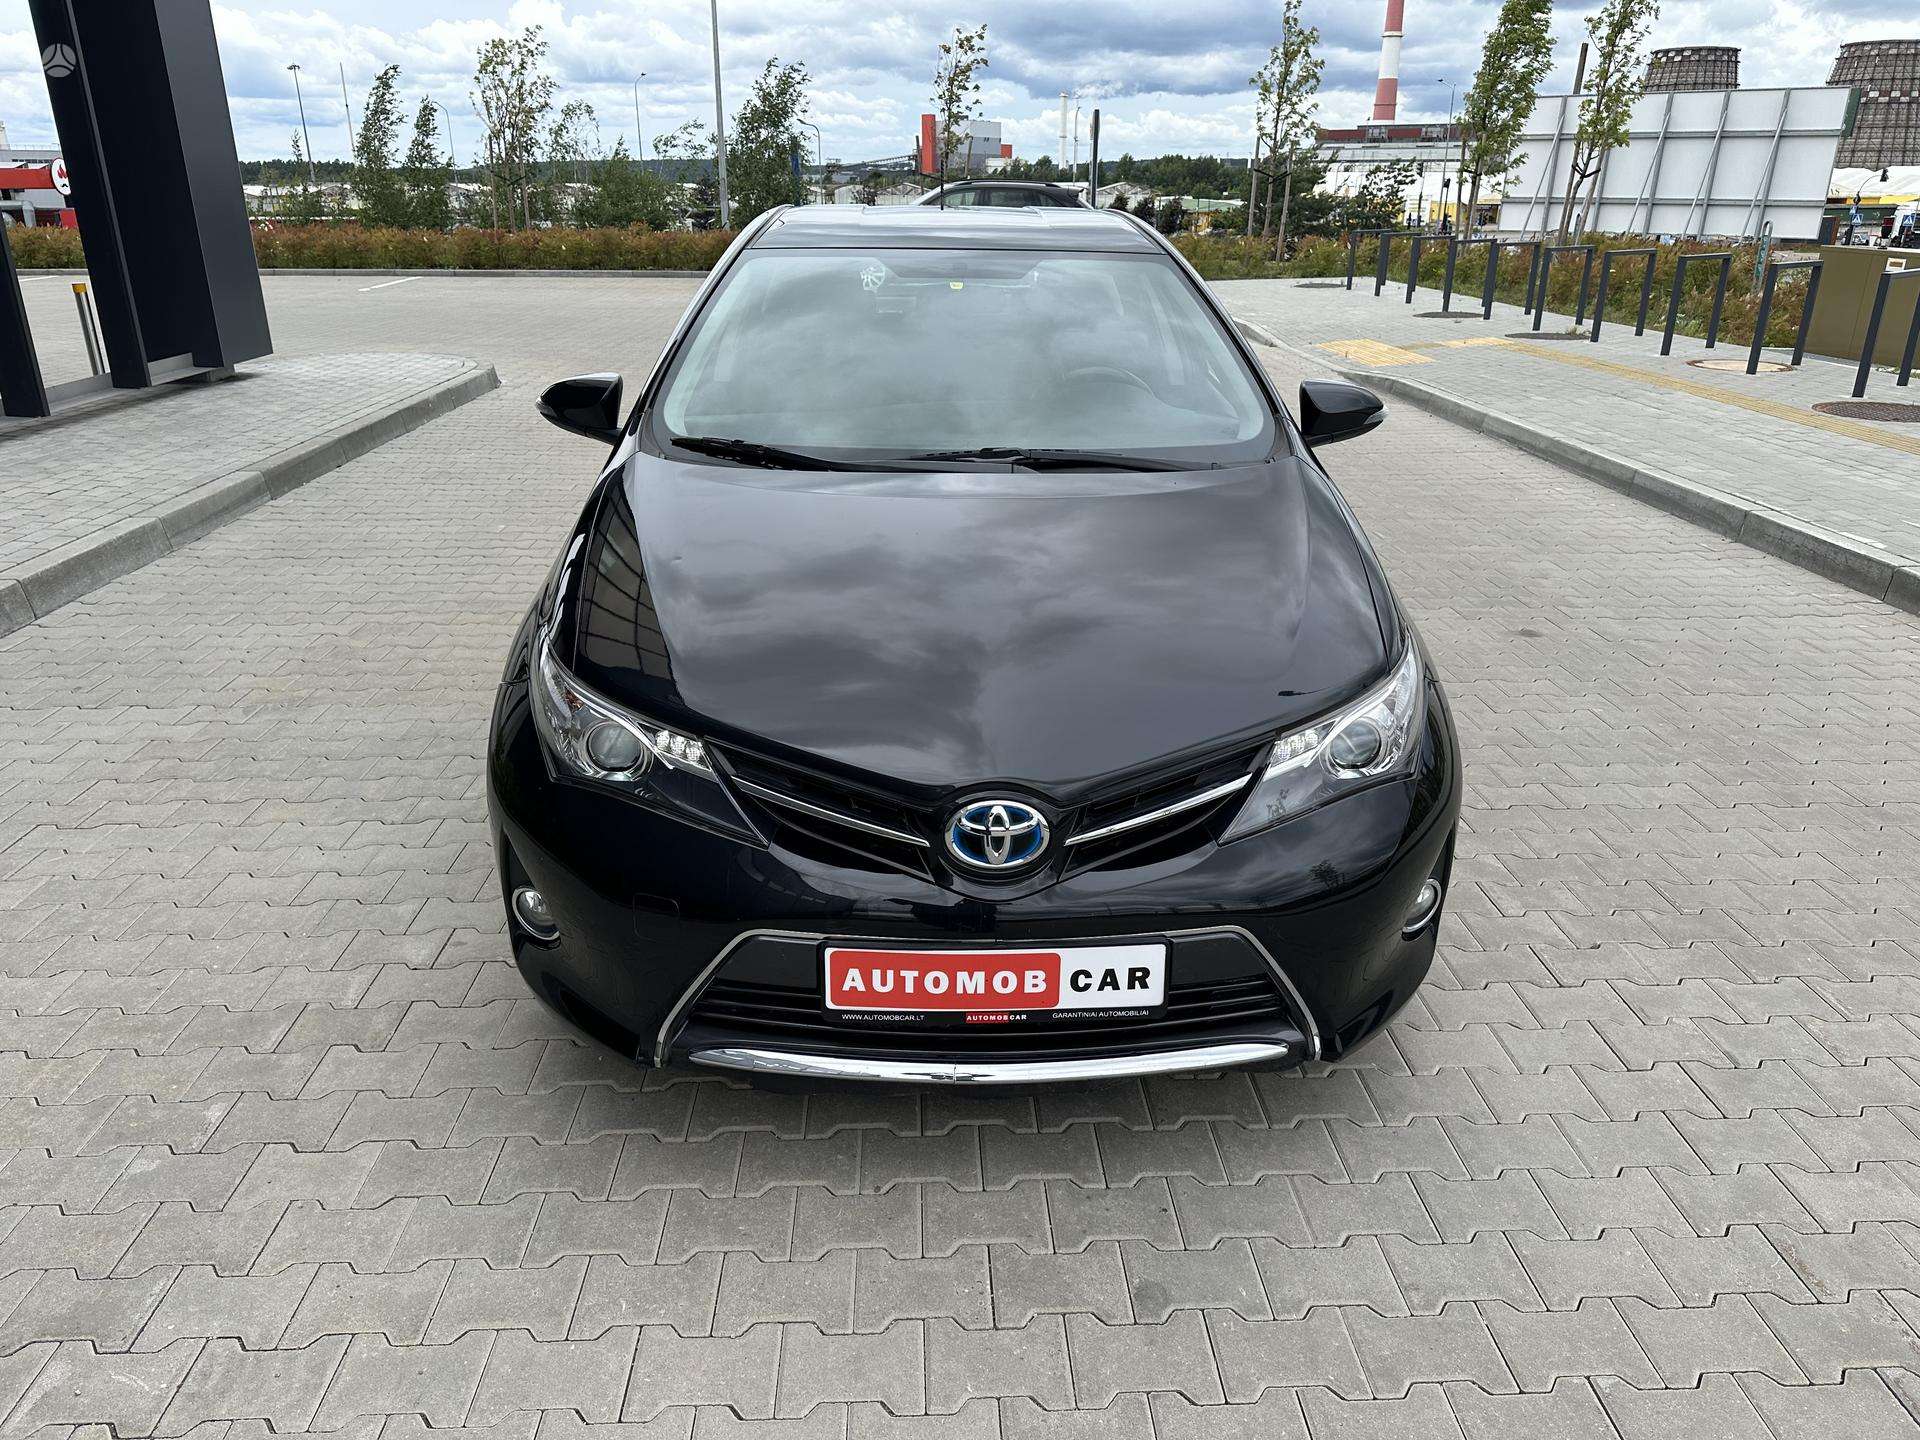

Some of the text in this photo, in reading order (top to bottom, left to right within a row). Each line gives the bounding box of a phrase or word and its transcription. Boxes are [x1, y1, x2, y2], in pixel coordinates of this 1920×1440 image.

[842, 966, 1151, 995] AUTOMOB CAR
[841, 1013, 925, 1021] WWW.AUTOMOBCAR.LT
[1098, 1009, 1149, 1018] AUTOMOBILIAI
